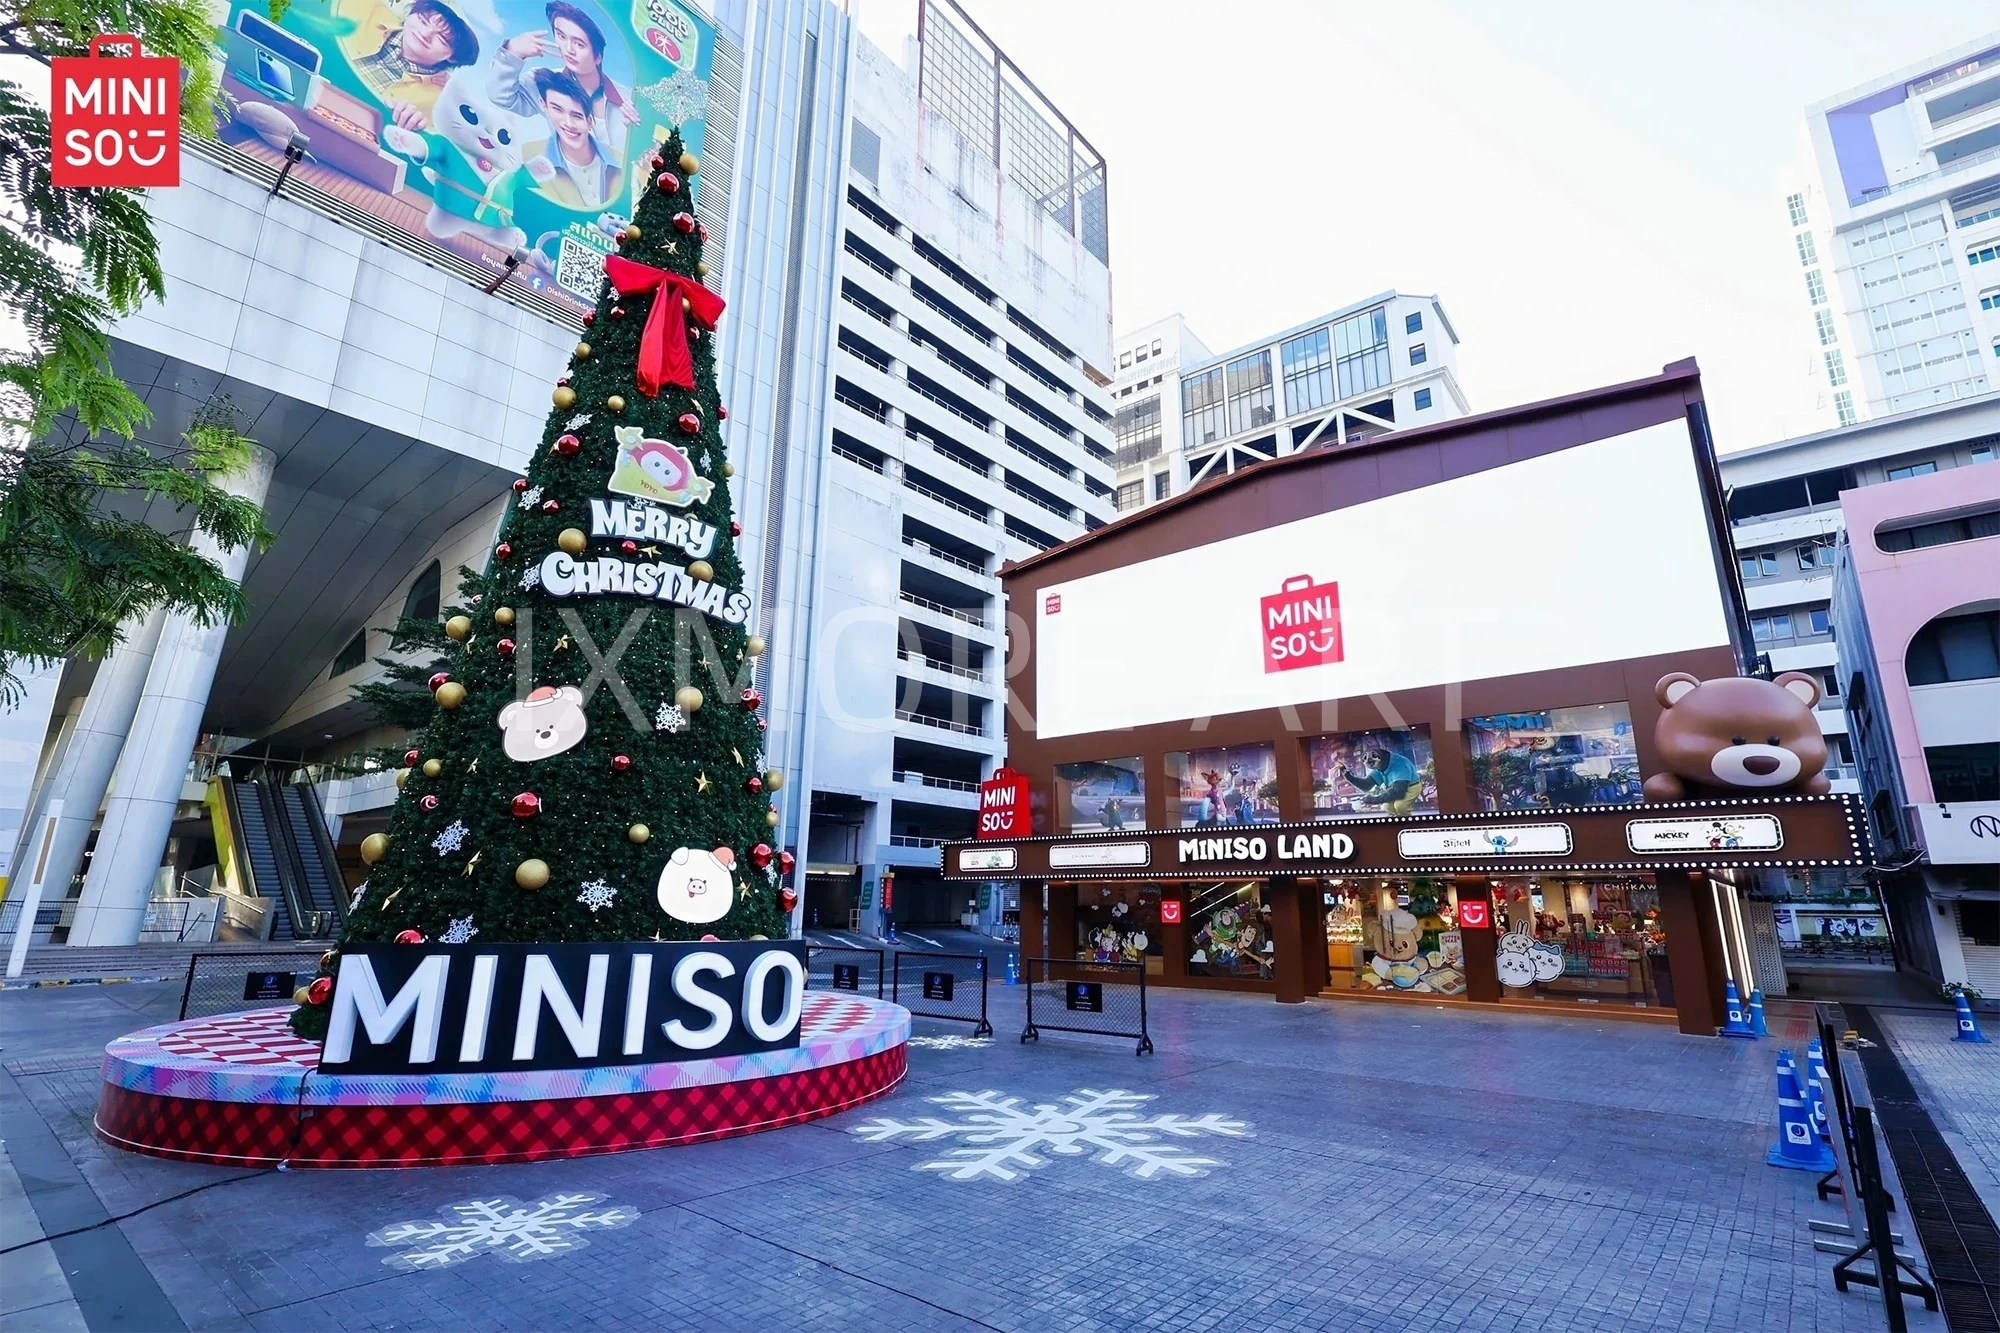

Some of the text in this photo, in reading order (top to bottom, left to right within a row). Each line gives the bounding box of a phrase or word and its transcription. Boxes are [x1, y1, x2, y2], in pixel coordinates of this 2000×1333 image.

[590, 498, 718, 559] MERRY
[540, 551, 752, 625] CHRISTMAS
[1046, 597, 1060, 606] MINI
[1268, 594, 1333, 631] MINI
[983, 785, 1016, 809] MINI
[1178, 832, 1355, 864] MINISO LAND
[1654, 832, 1690, 840] MICKEY
[322, 950, 804, 1064] MINISO
